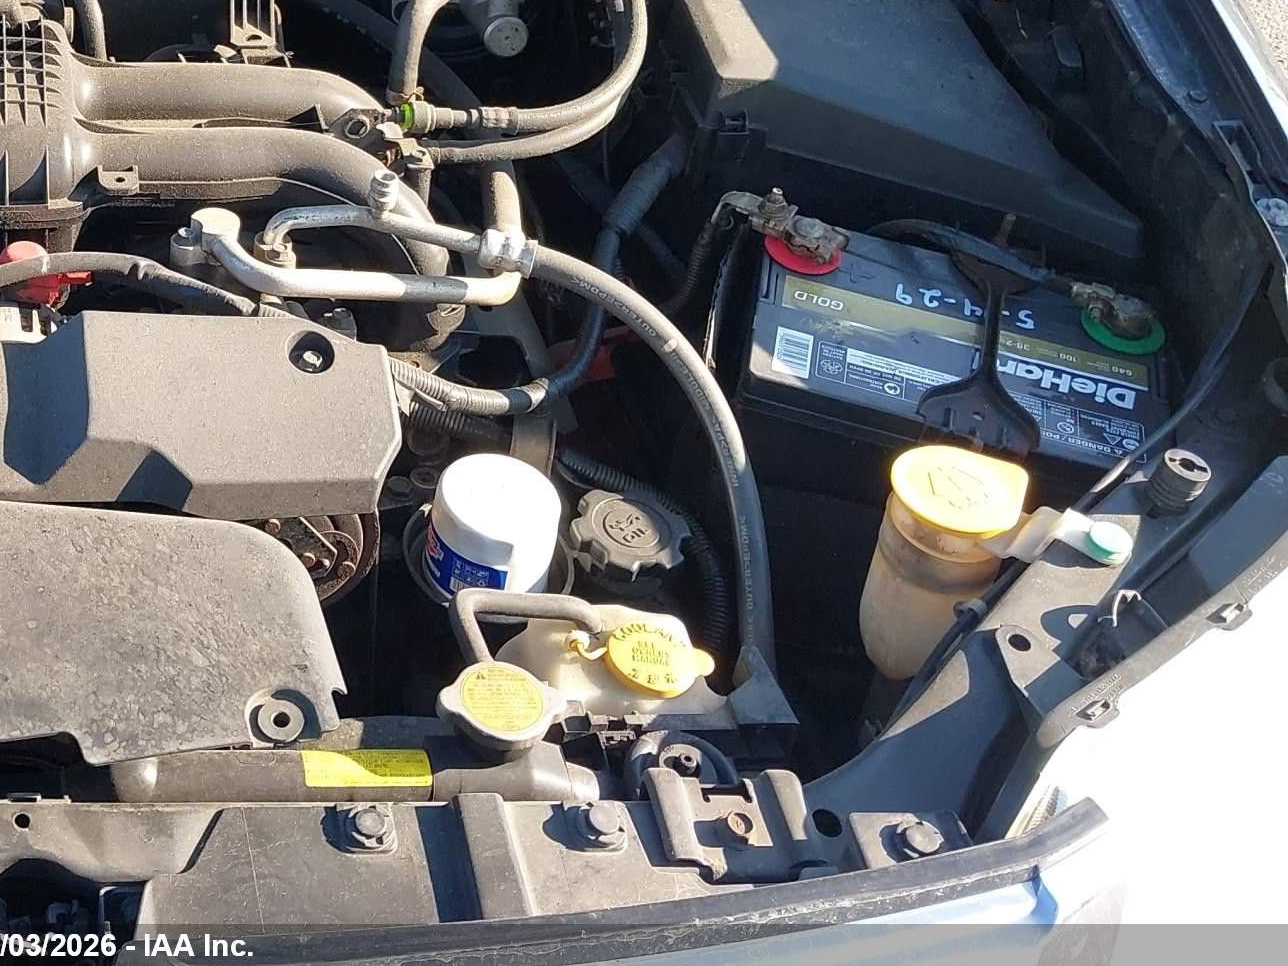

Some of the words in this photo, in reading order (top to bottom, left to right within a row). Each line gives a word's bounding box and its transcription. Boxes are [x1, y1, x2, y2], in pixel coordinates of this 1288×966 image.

[793, 290, 845, 311] GOLD
[1059, 352, 1078, 363] 100
[1111, 366, 1133, 376] 640
[1067, 436, 1112, 453] DANGER
